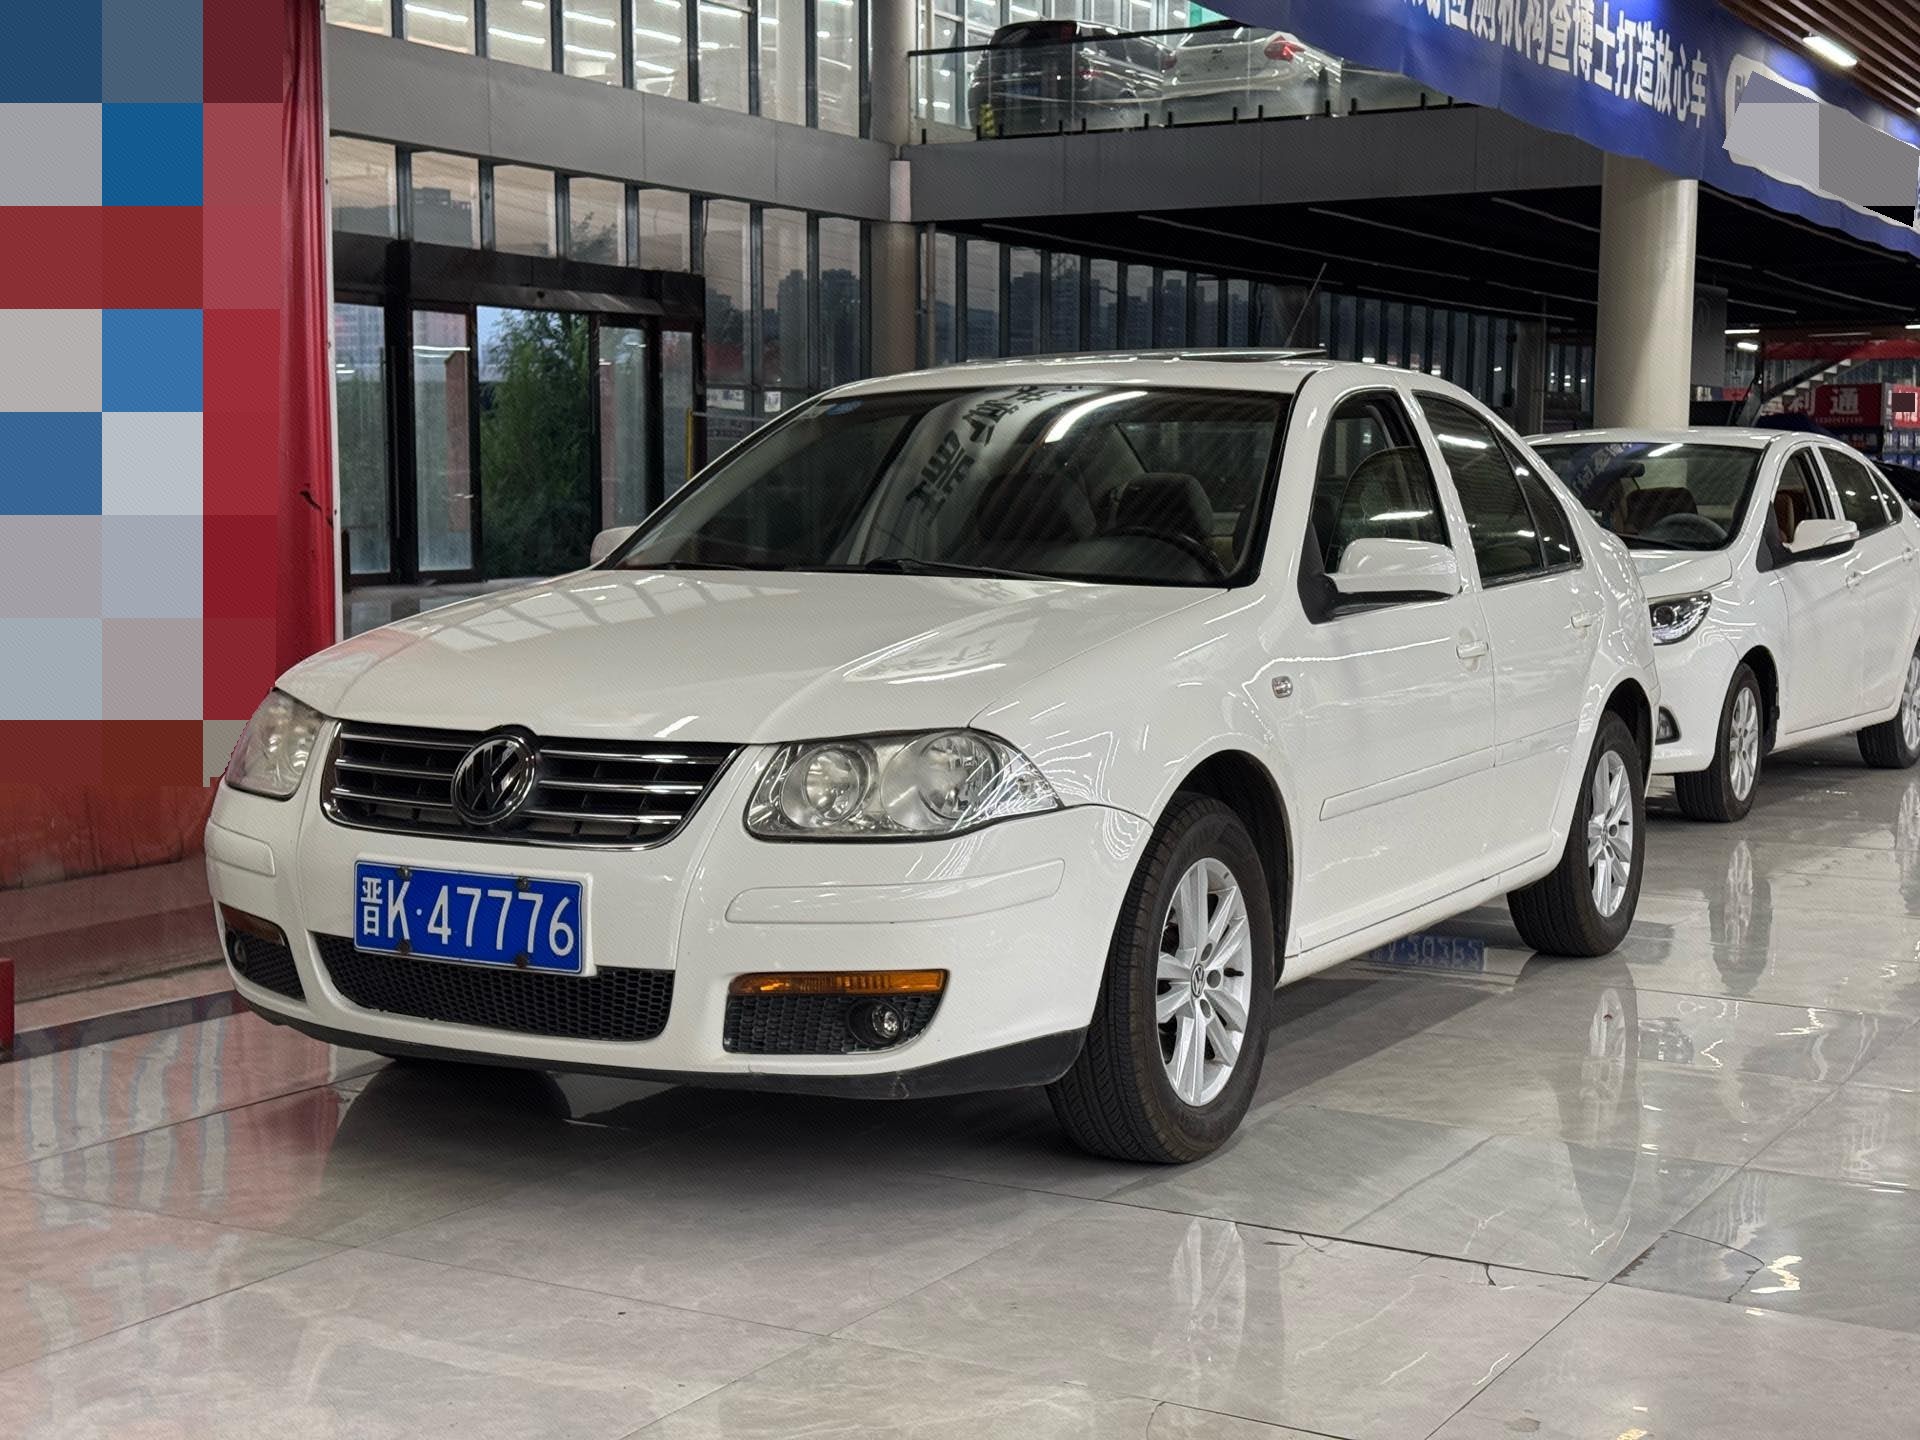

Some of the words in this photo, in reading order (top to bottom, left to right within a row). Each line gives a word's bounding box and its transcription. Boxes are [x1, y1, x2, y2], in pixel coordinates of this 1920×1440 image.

[1408, 0, 1707, 128] 机构查博士打造放心车
[360, 876, 575, 957] 晋K·47776
